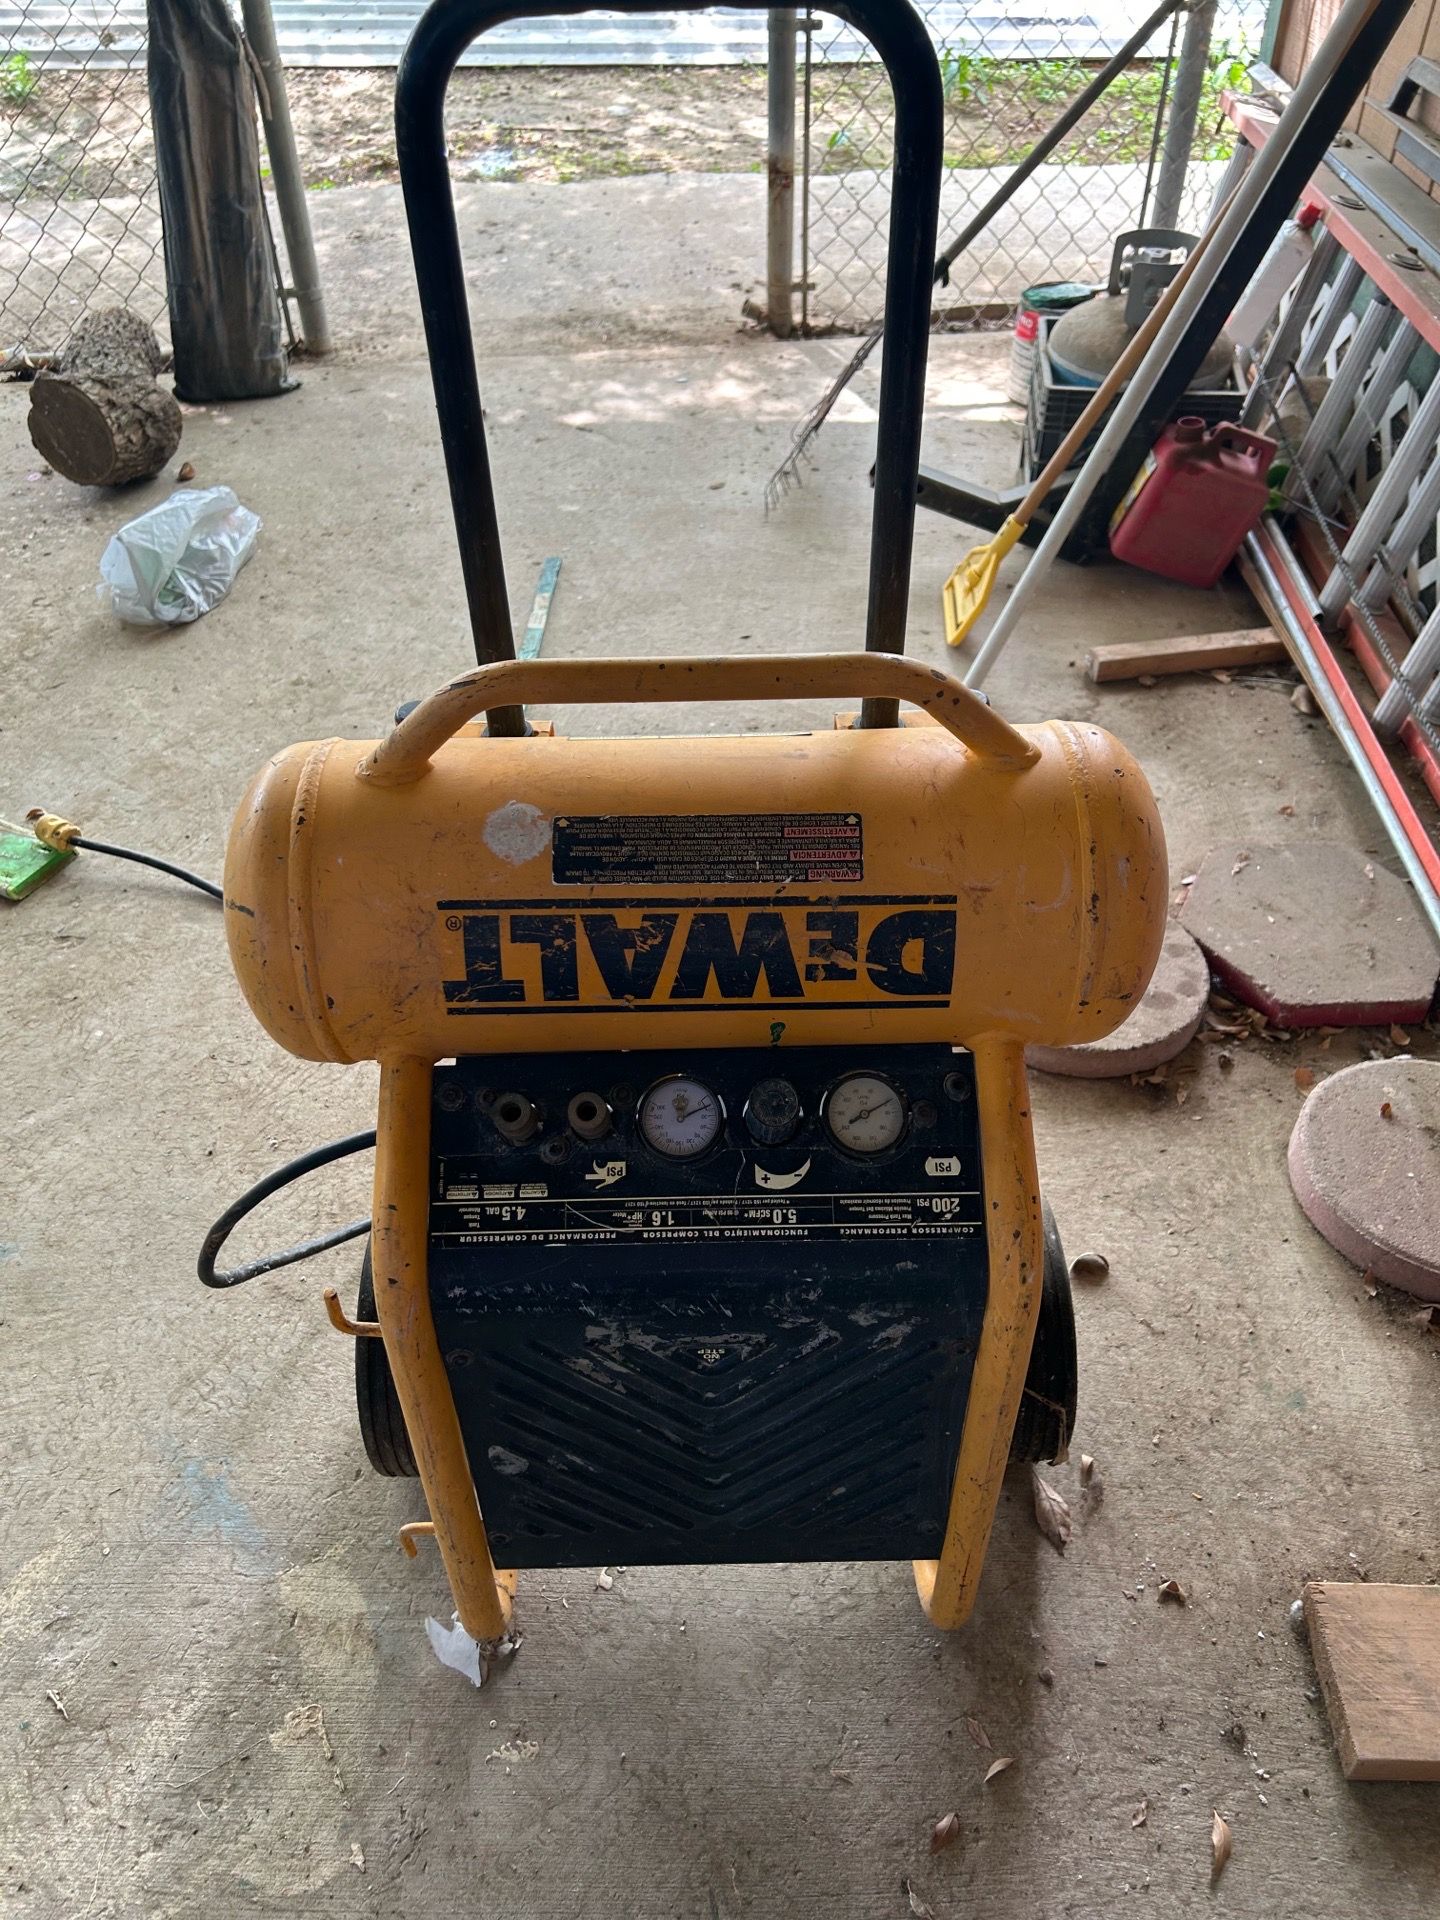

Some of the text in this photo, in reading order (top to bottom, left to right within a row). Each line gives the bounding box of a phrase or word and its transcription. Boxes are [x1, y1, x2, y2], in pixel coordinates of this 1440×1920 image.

[786, 827, 847, 835] AVERTISSEMENT
[793, 851, 847, 859] ADVERTENCIA
[810, 870, 850, 878] WARNING
[442, 910, 956, 1002] DEWALT
[607, 1167, 623, 1177] PSI
[935, 1162, 951, 1172] PSI
[916, 1198, 960, 1212] 200 PSI
[485, 1206, 526, 1220] 4.5 GAL
[652, 1210, 675, 1226] 1.6
[773, 1209, 797, 1223] 5.0
[548, 1232, 616, 1240] PERFORMANCE
